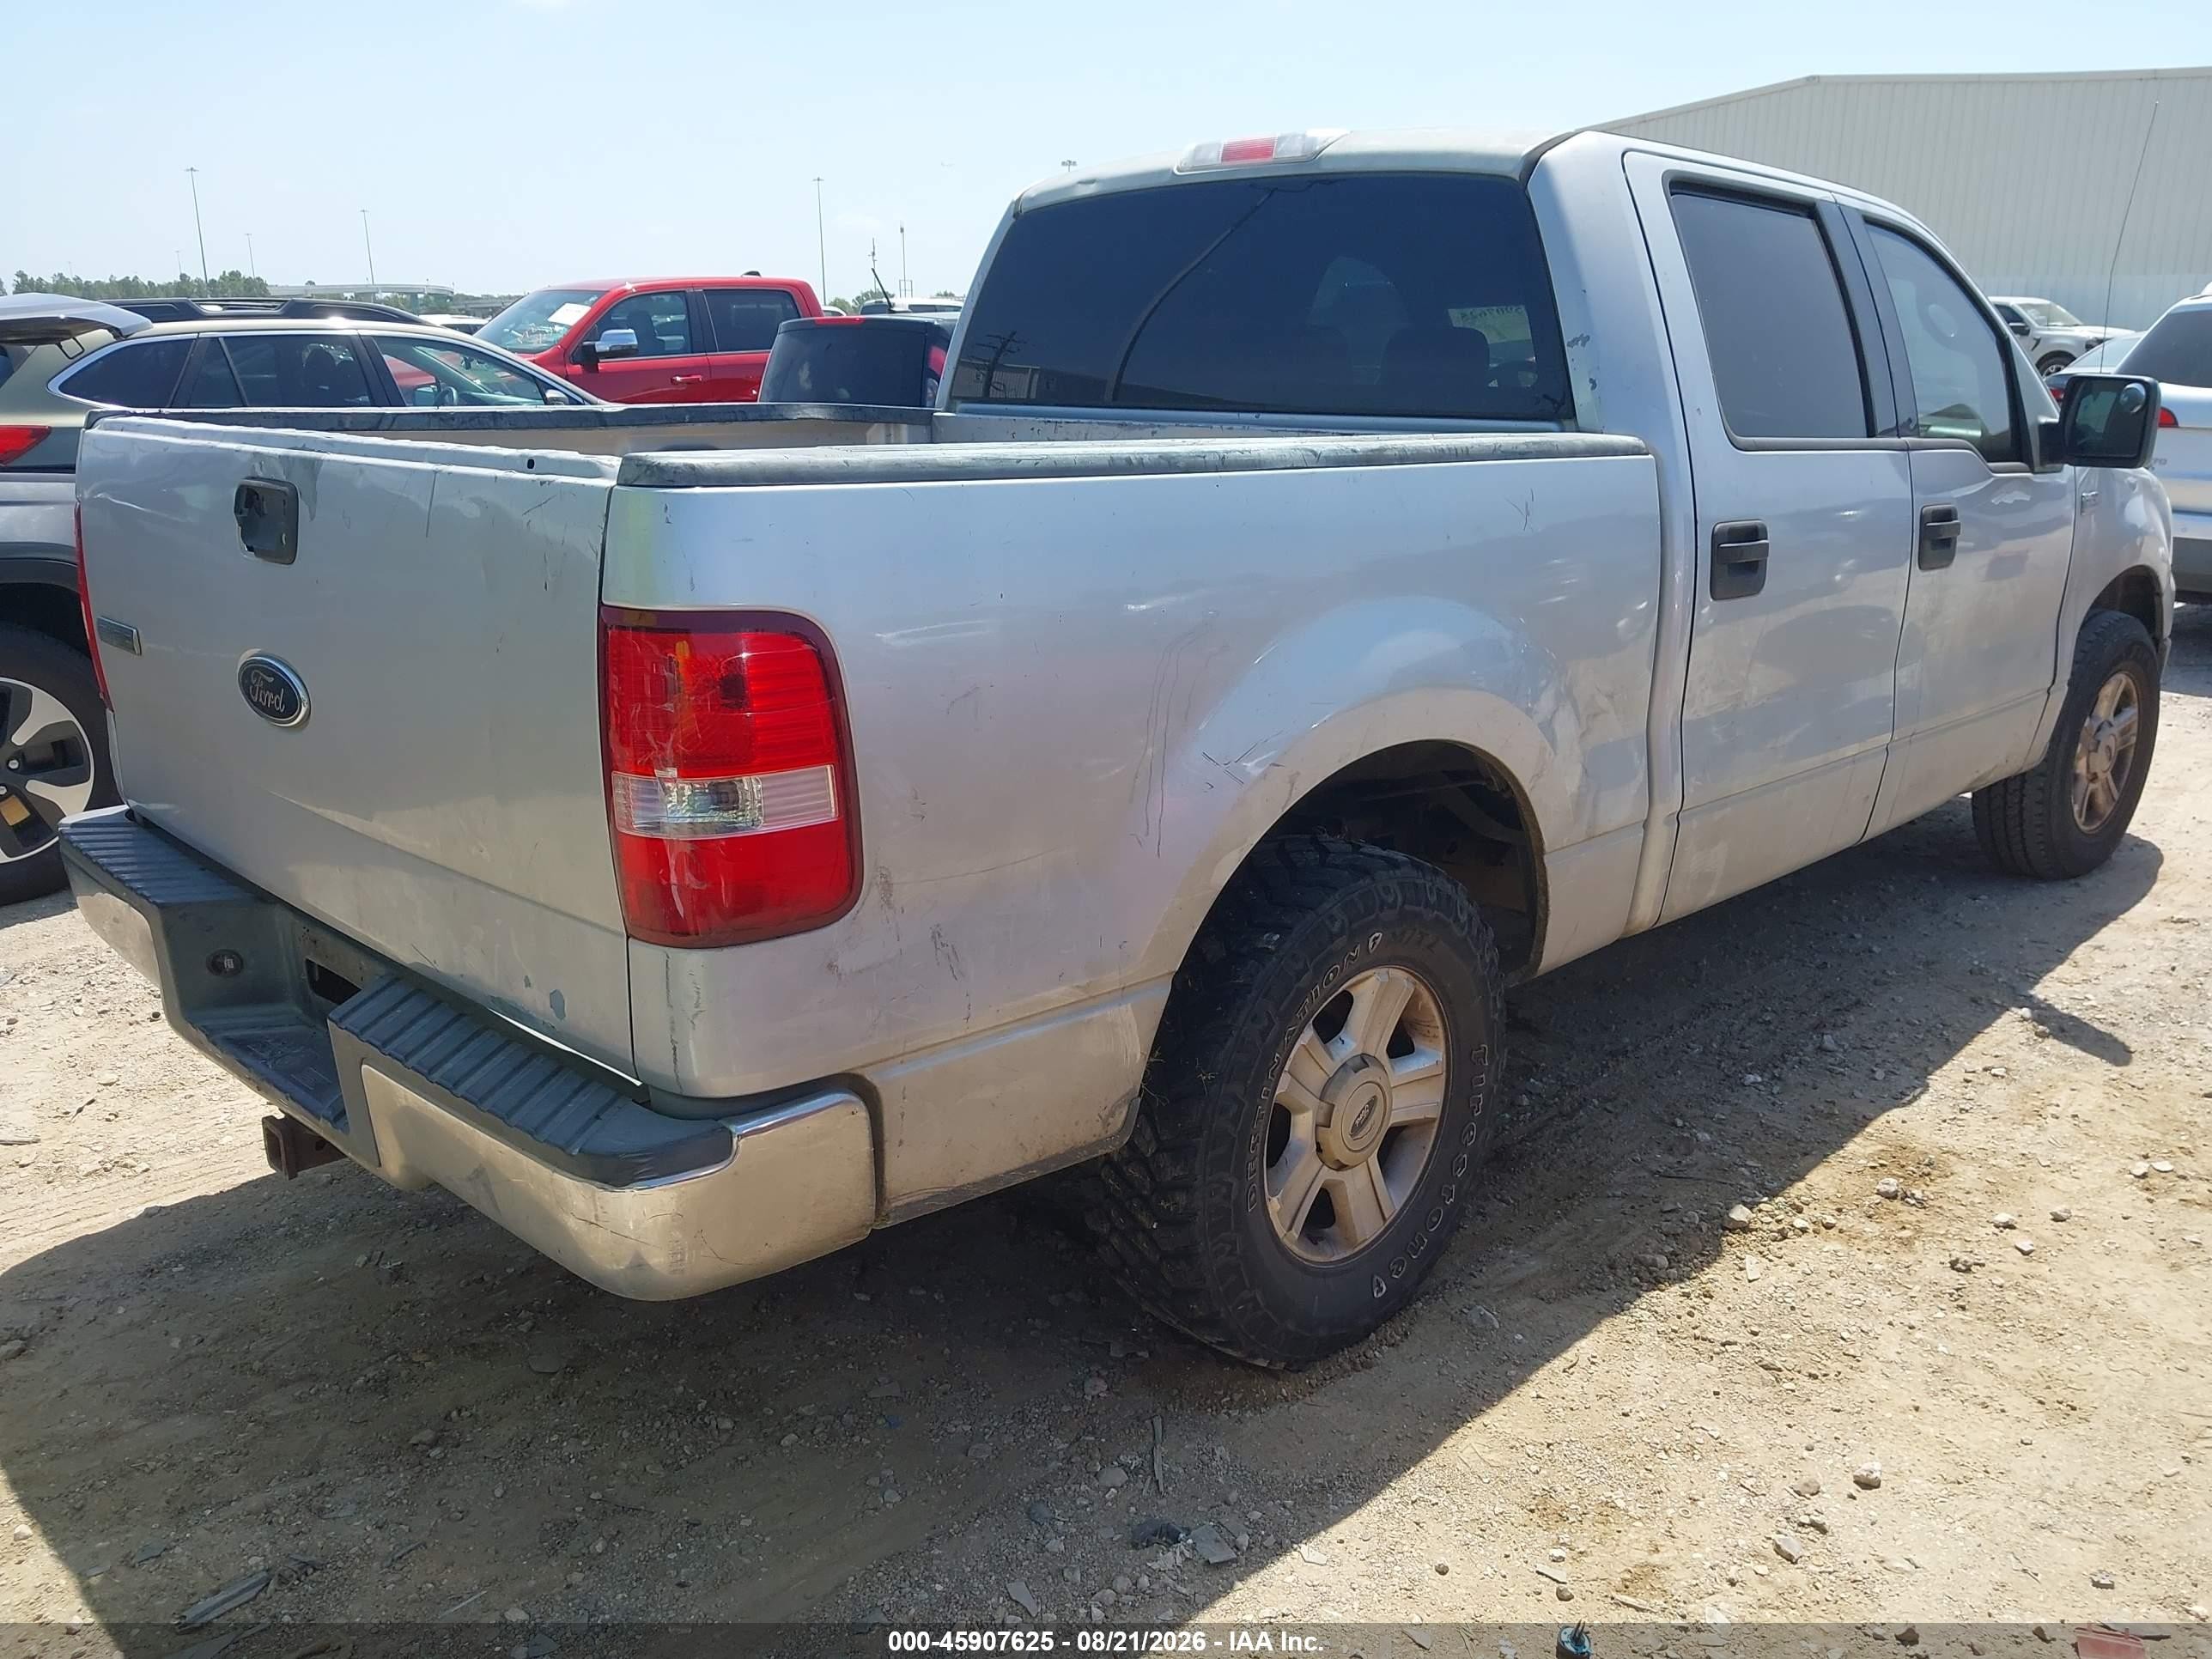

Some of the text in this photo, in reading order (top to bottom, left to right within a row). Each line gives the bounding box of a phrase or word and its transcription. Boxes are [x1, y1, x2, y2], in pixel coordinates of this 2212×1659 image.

[248, 669, 286, 713] Ford
[1247, 943, 1362, 1213] DESTINATION
[1388, 1042, 1488, 1279] Firestone
